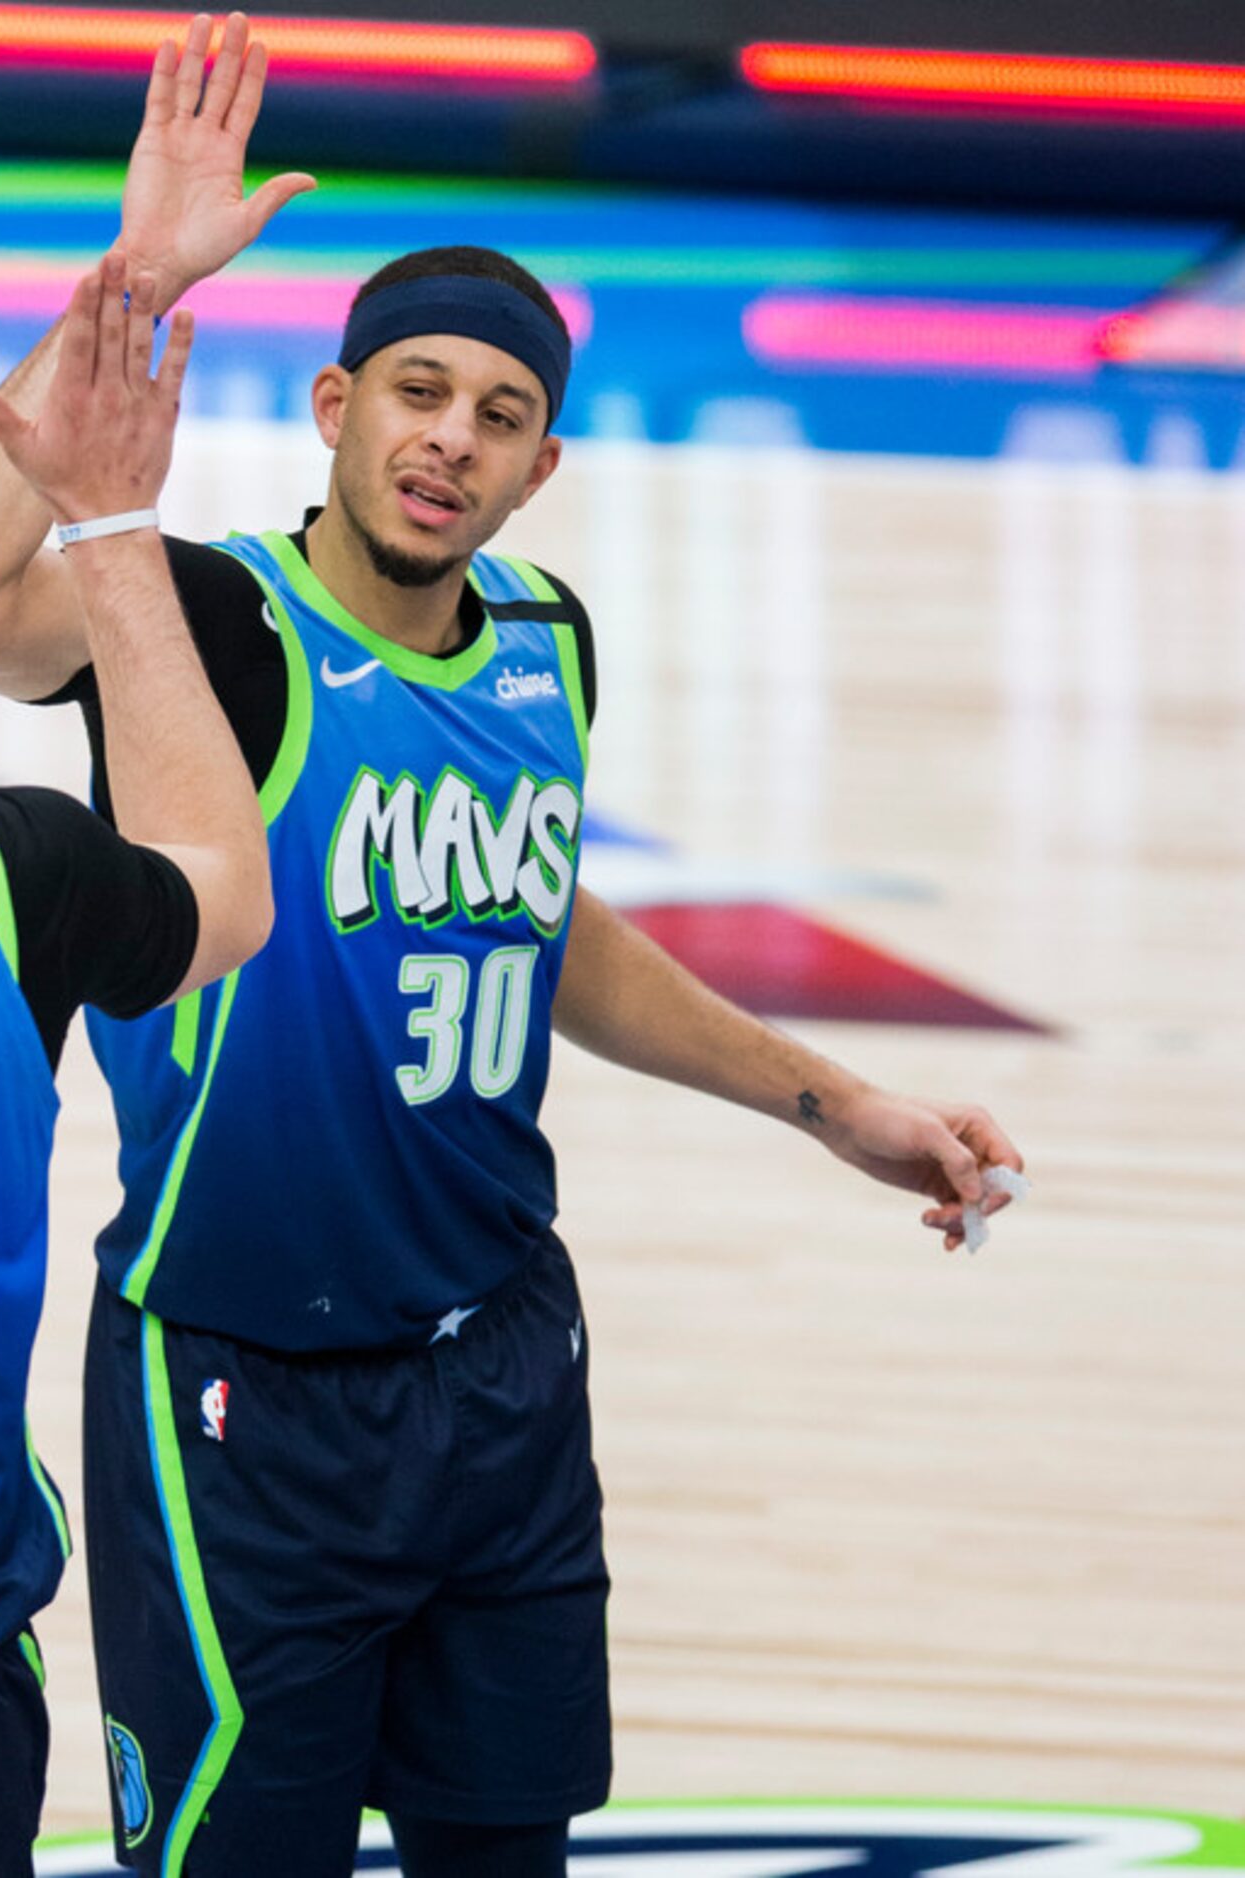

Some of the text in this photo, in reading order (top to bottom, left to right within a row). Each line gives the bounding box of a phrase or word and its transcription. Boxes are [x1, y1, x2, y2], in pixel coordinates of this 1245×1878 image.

[496, 665, 559, 700] chime
[326, 763, 583, 938] MAVS
[394, 945, 540, 1106] 30
